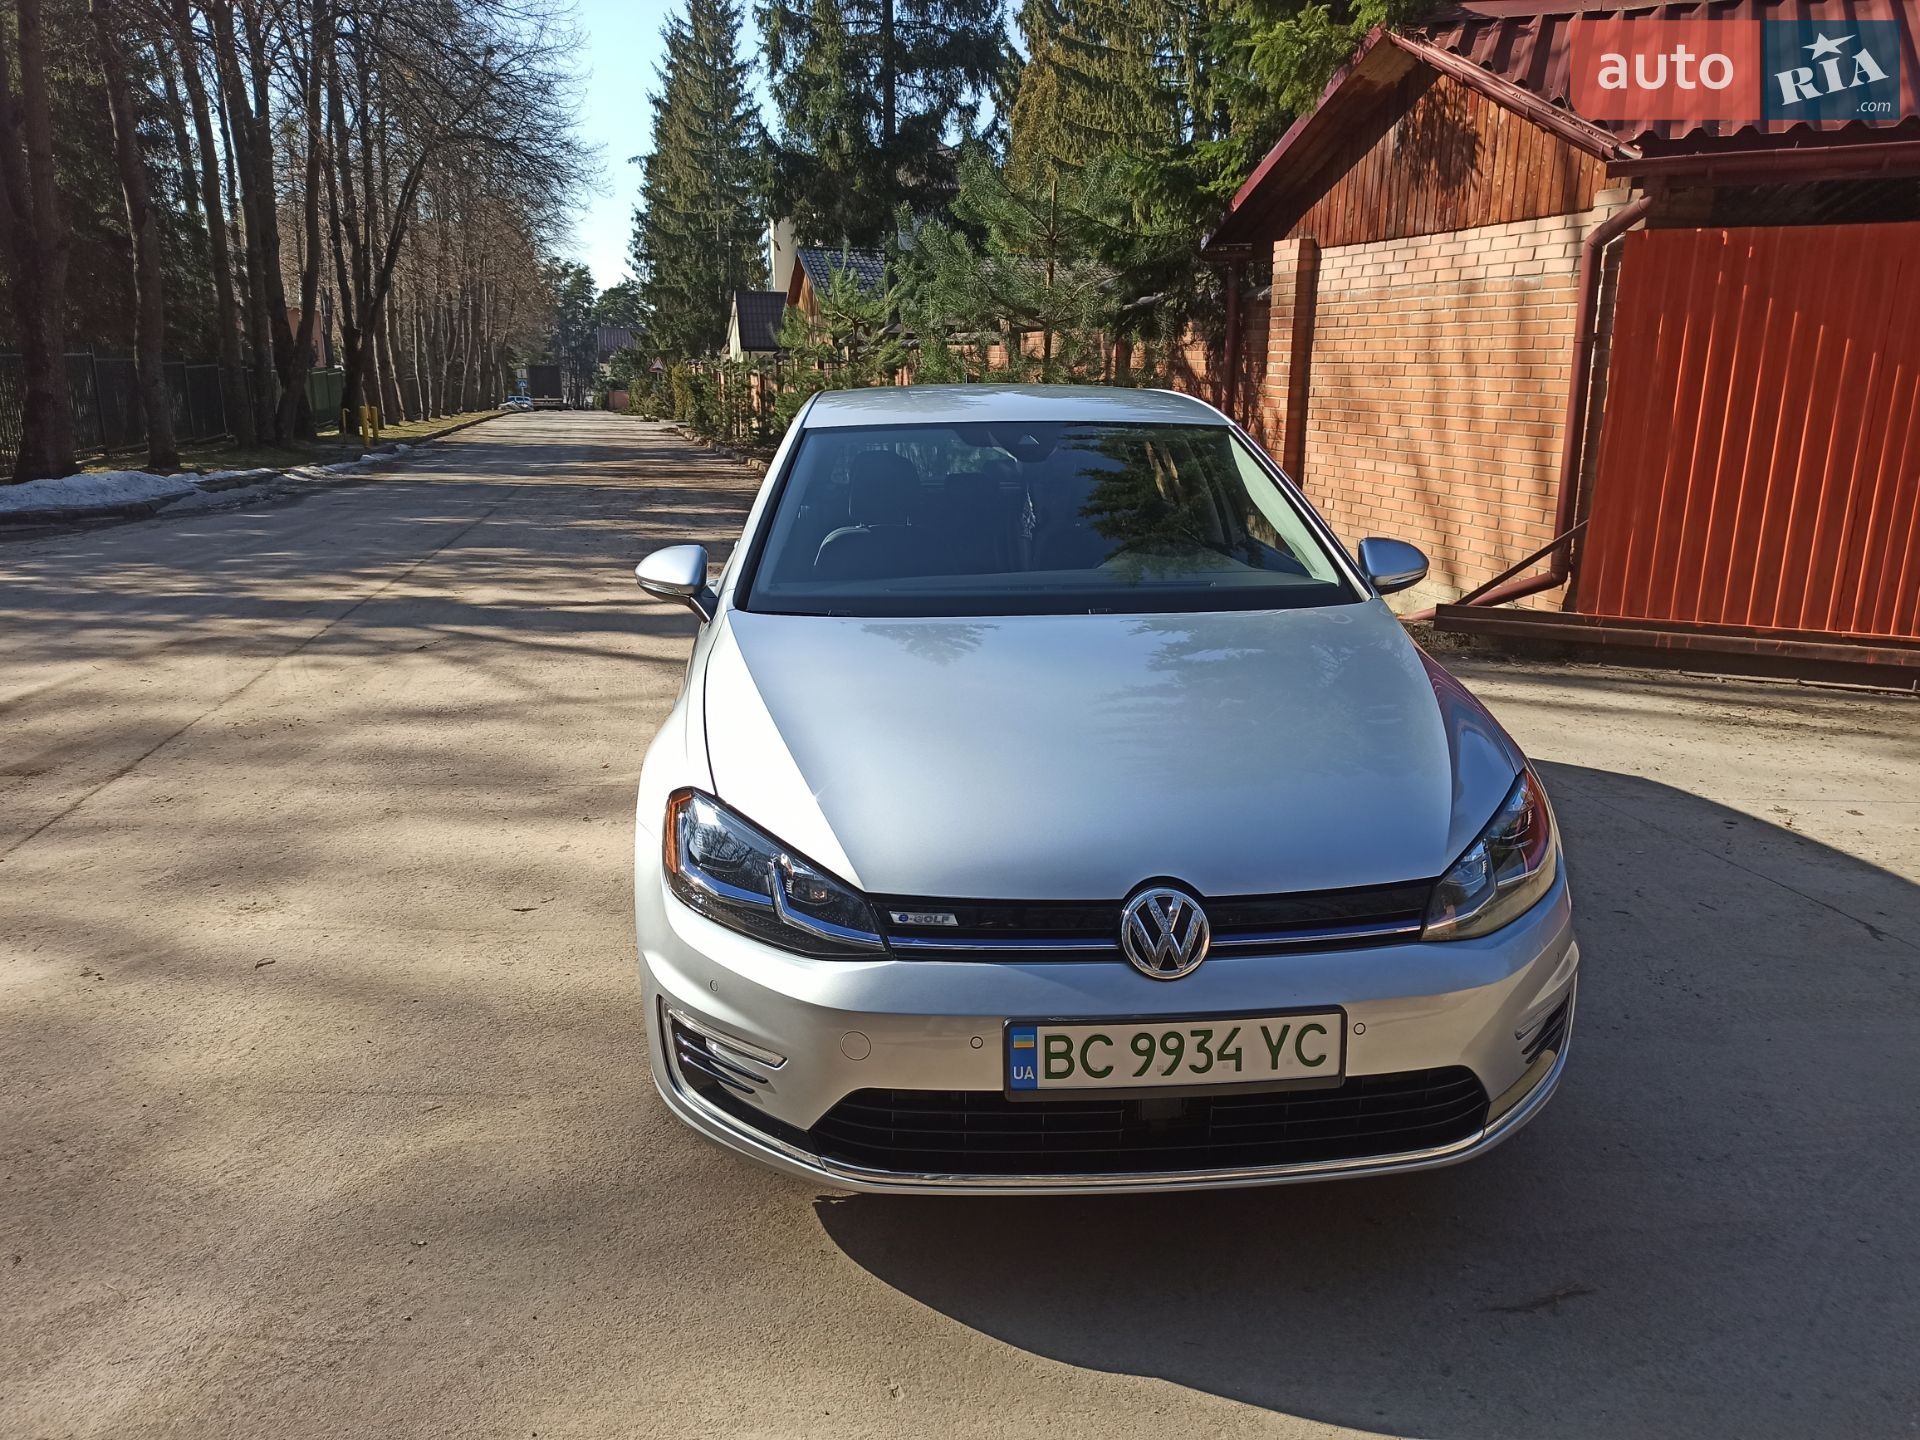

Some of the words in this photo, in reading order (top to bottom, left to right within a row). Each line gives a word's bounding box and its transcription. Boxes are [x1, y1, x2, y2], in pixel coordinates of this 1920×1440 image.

[1044, 1034, 1114, 1080] BC
[1130, 1026, 1243, 1077] 9934
[1260, 1023, 1328, 1071] YC
[1013, 1066, 1035, 1080] UA
